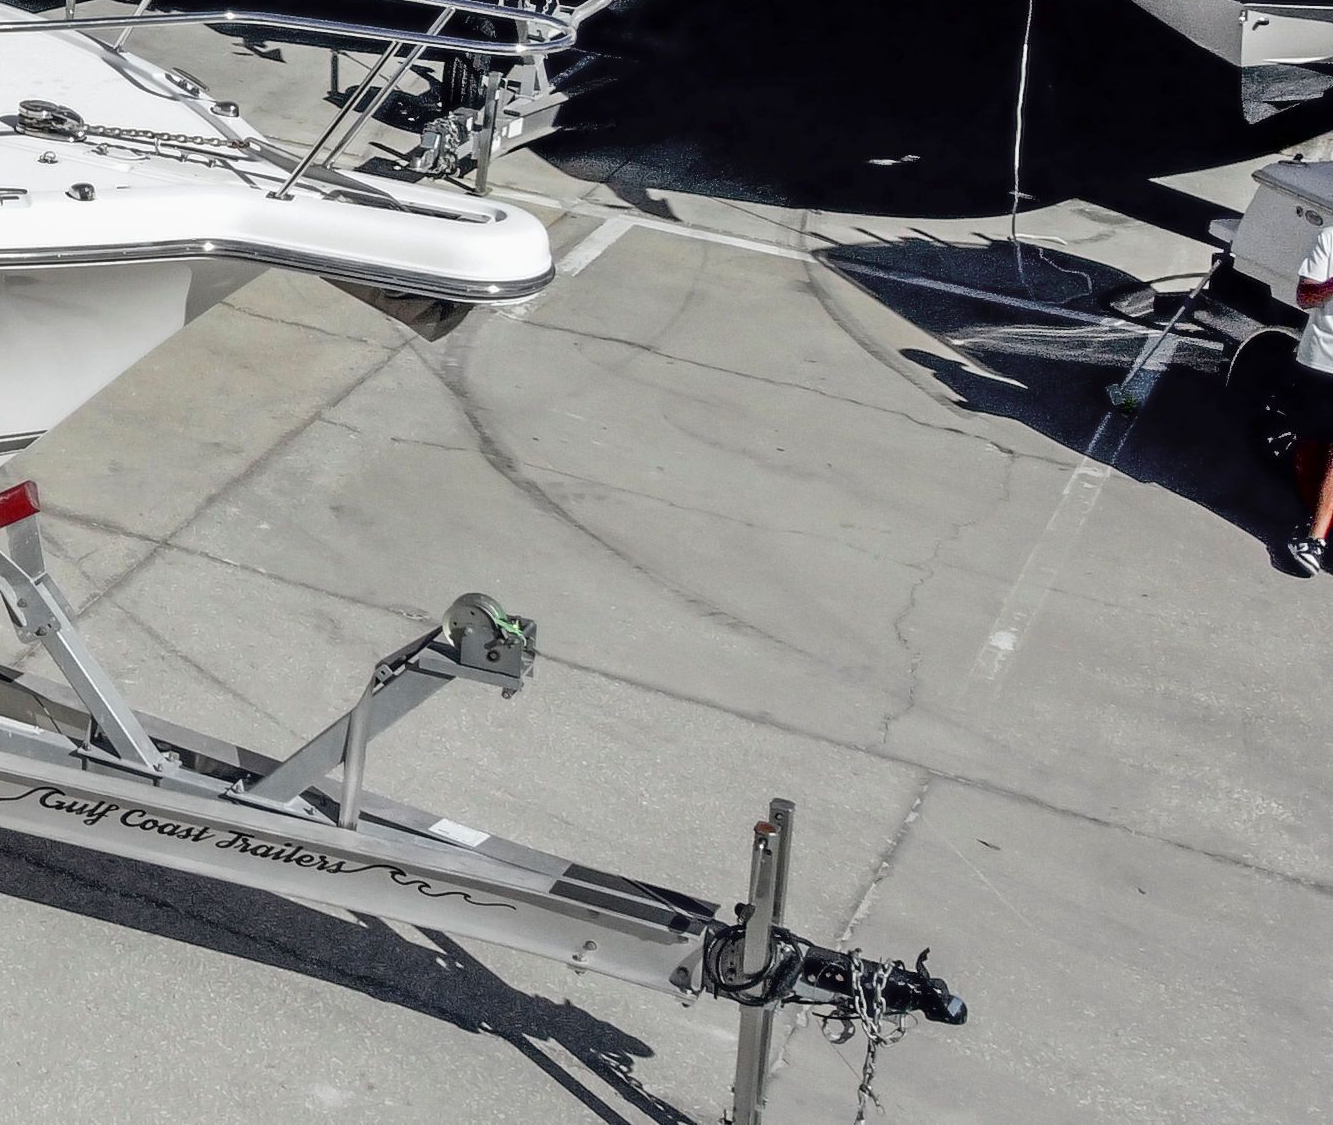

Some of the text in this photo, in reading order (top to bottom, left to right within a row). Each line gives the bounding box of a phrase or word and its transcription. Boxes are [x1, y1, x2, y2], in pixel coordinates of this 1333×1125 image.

[37, 787, 354, 874] Gulf Coast Trailers
